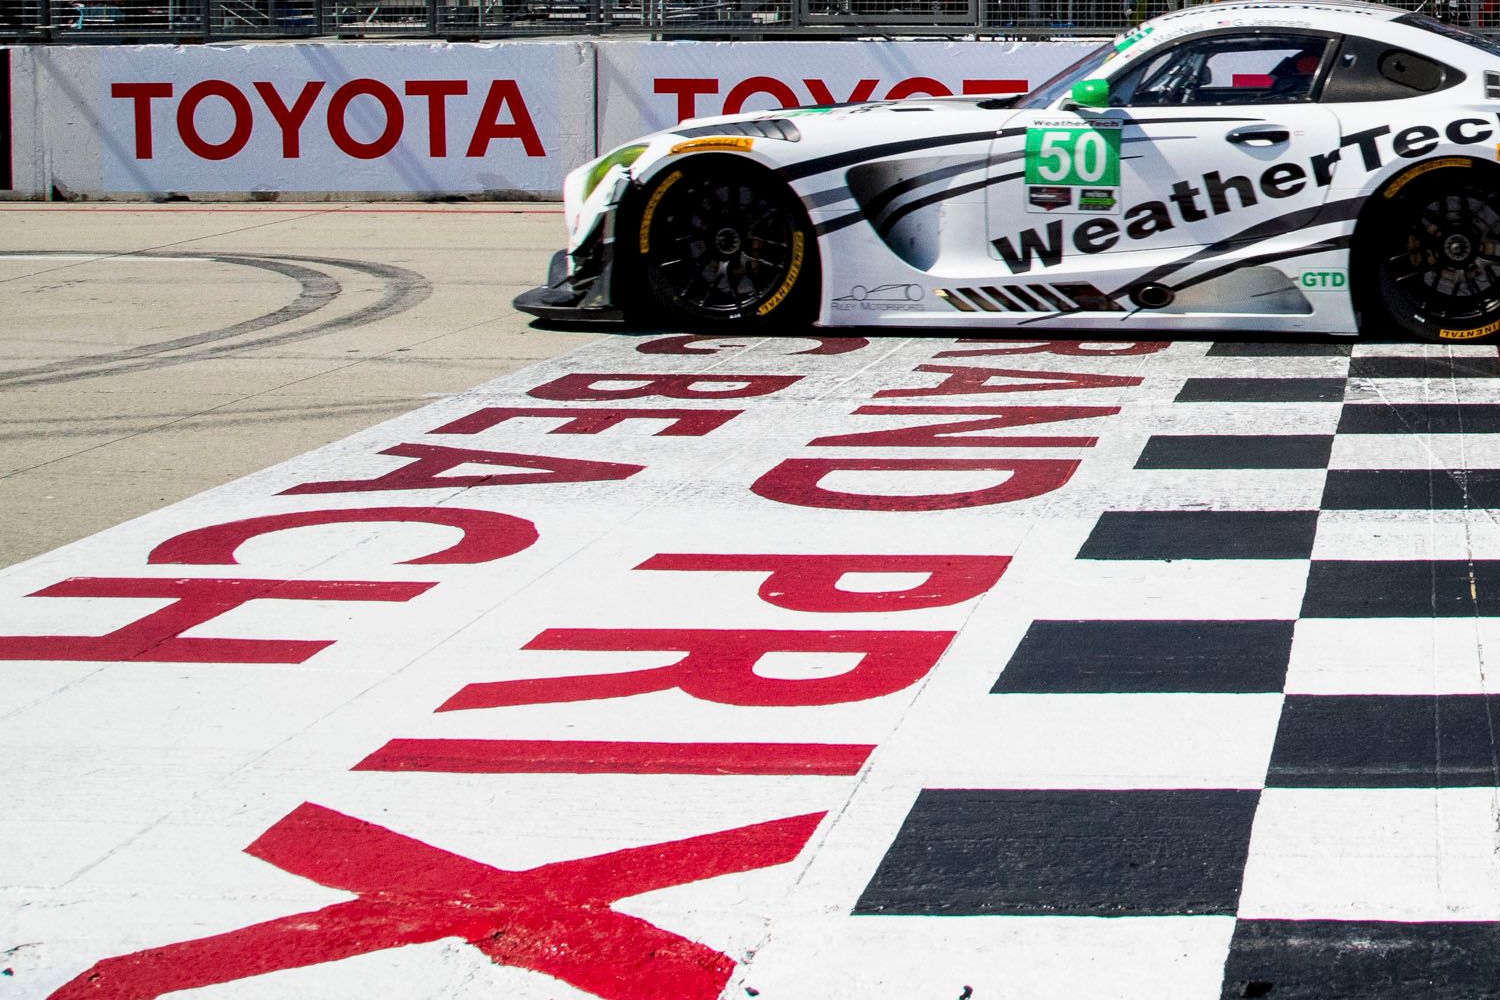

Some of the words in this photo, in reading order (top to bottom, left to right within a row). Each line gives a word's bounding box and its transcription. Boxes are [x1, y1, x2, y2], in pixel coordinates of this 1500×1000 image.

[112, 79, 546, 159] TOYOTA
[1038, 131, 1107, 182] 50
[1301, 271, 1345, 288] GTD
[752, 337, 1172, 512] RAND
[0, 374, 804, 664] BEACH
[47, 553, 1013, 1000] PRIX
